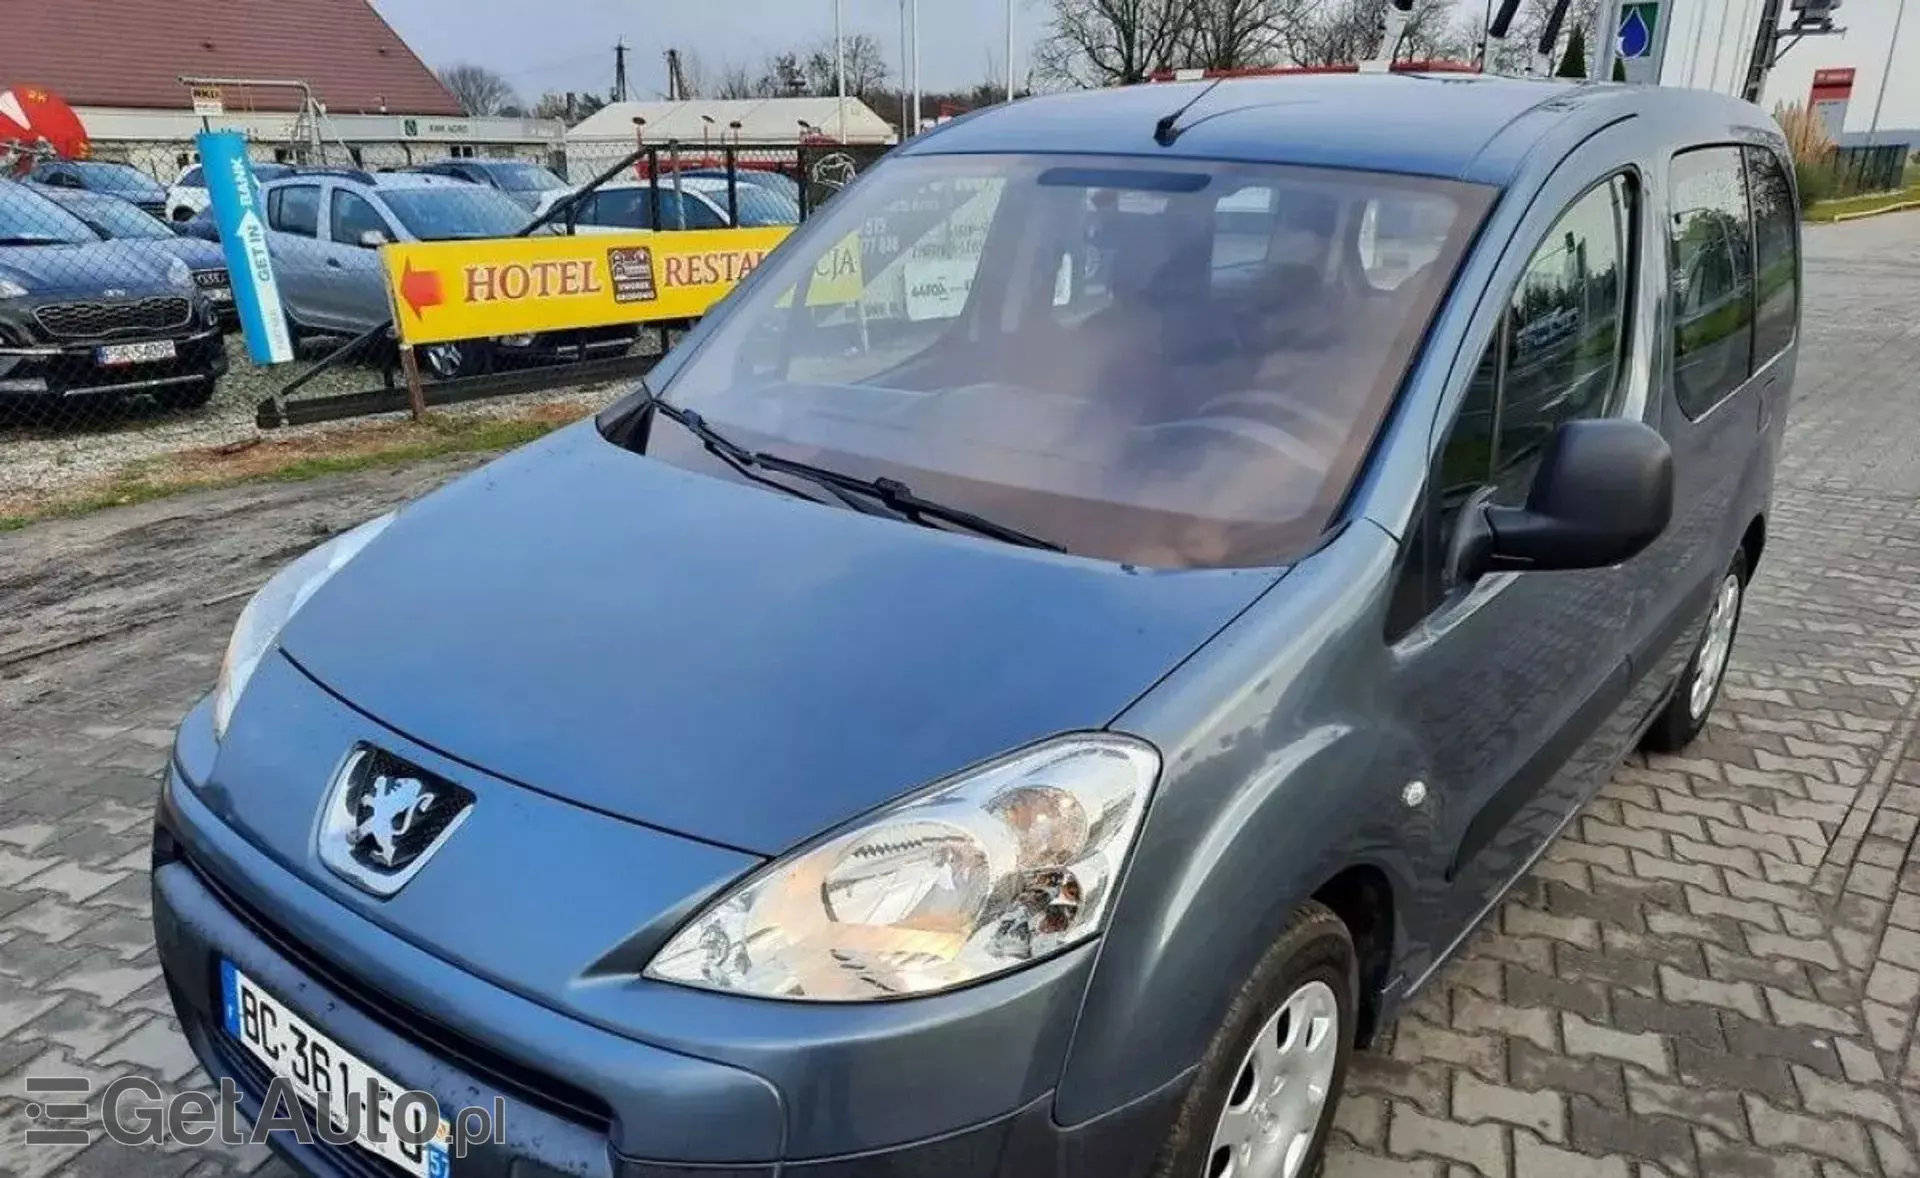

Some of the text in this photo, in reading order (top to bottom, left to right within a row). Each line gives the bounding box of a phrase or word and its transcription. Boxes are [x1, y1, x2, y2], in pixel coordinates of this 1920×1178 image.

[231, 157, 270, 282] GET IN BANK
[464, 261, 601, 303] HOTEL
